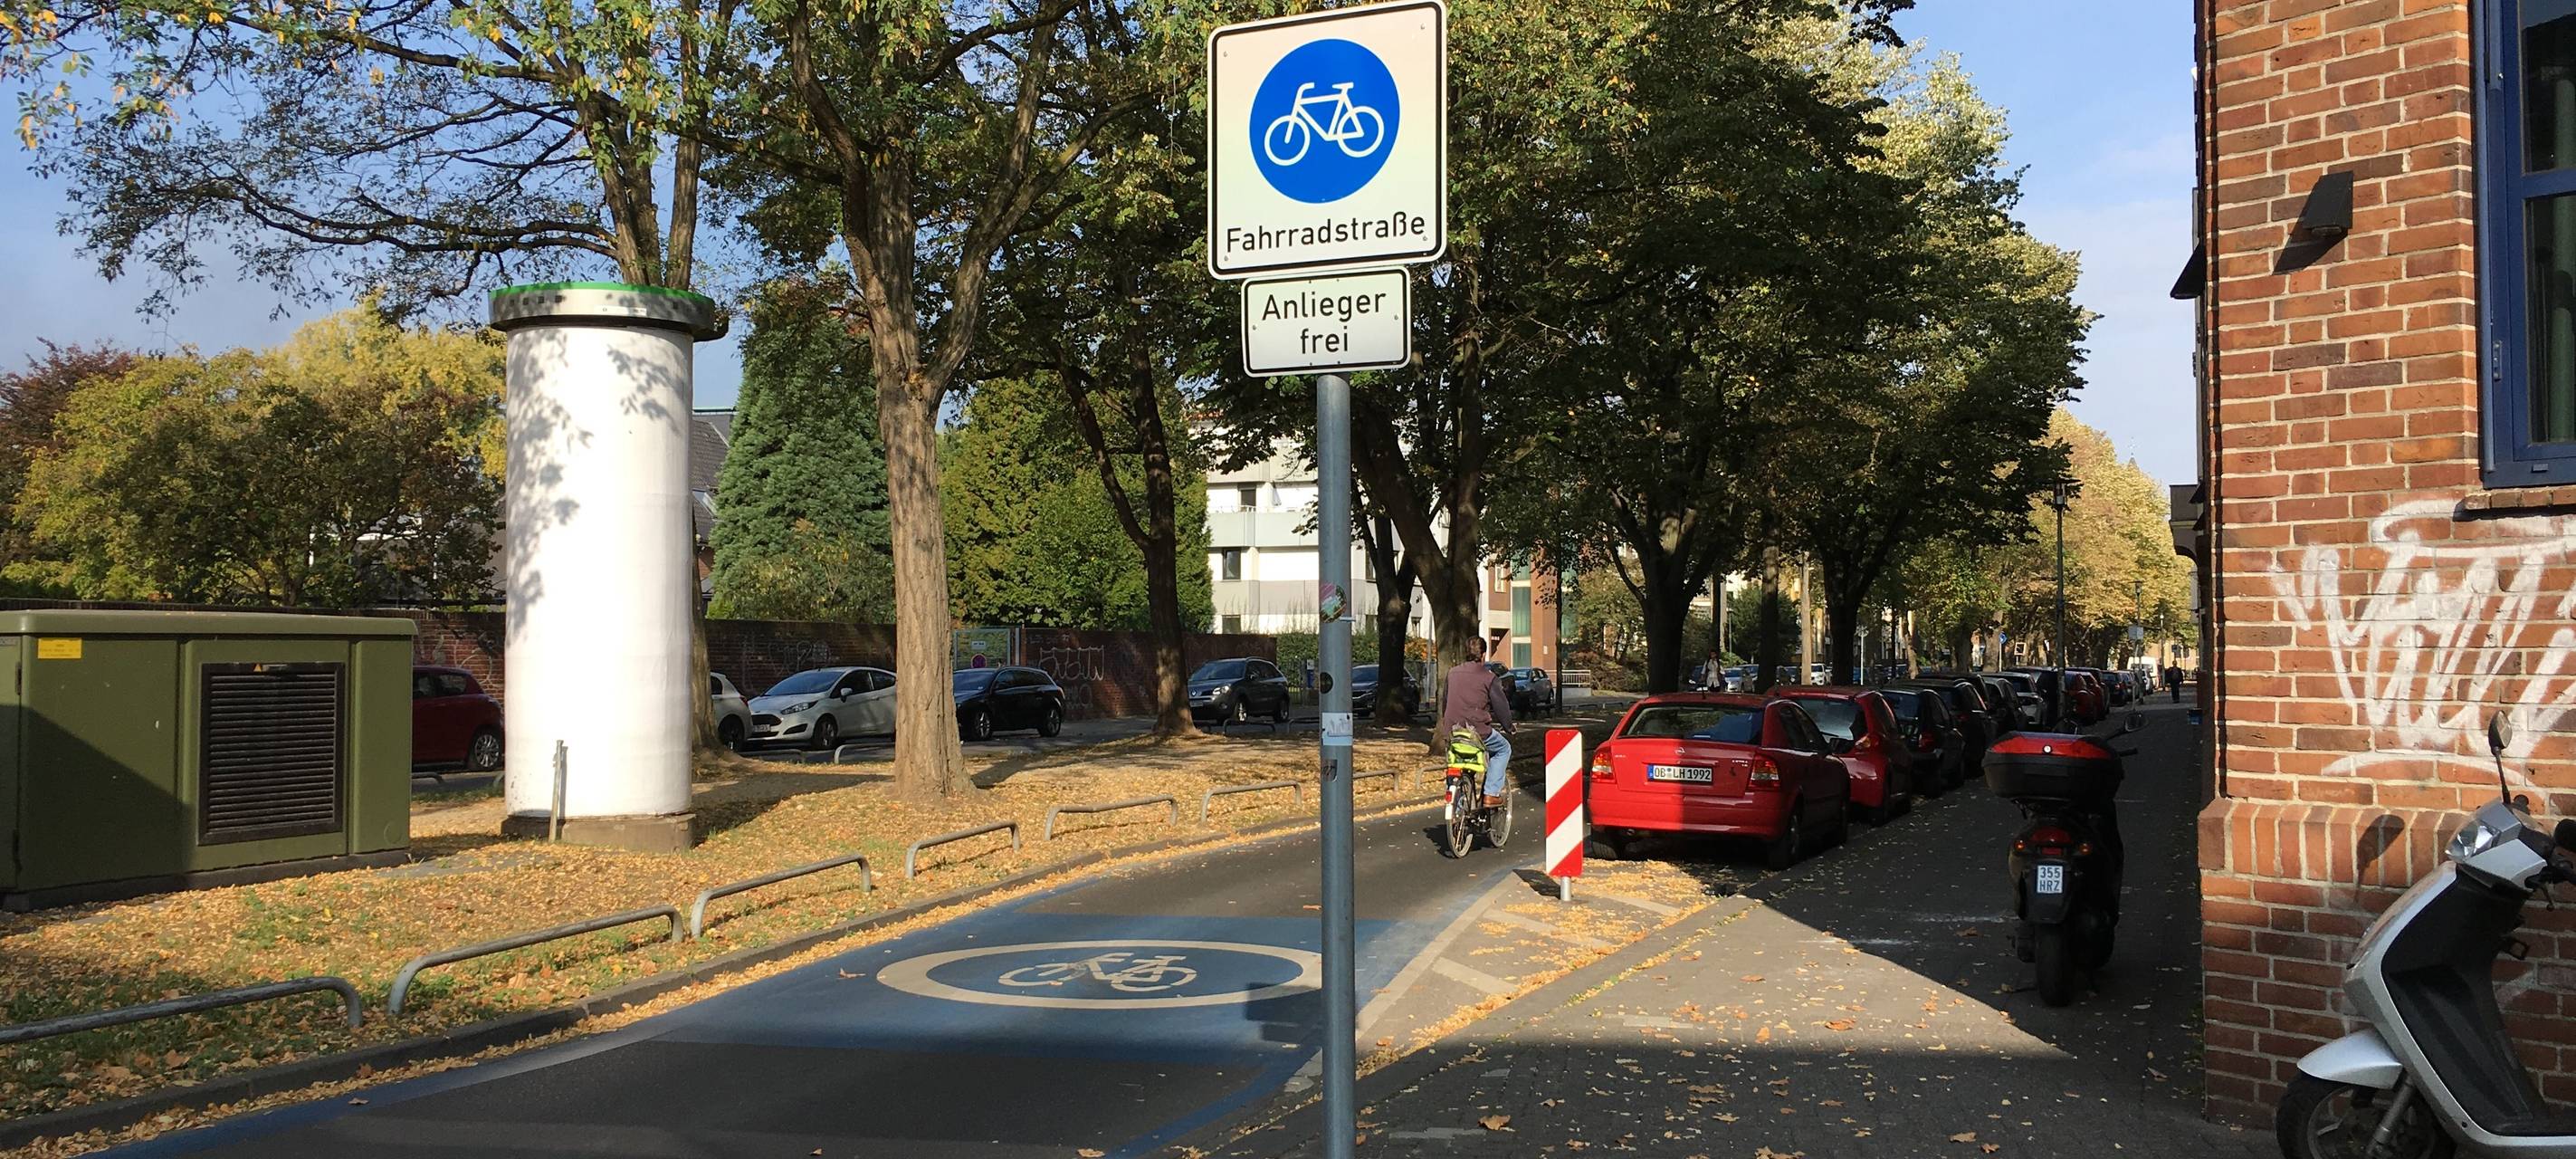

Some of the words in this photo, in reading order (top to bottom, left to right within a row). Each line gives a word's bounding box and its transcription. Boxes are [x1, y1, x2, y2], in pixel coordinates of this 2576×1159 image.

[1226, 211, 1426, 254] Fahrradstraße
[1262, 291, 1387, 322] Anlieger
[1300, 325, 1349, 355] frei
[1673, 768, 1685, 779] LH
[1686, 769, 1712, 781] 1992
[2039, 867, 2061, 879] 355
[2039, 879, 2061, 892] HRZ
